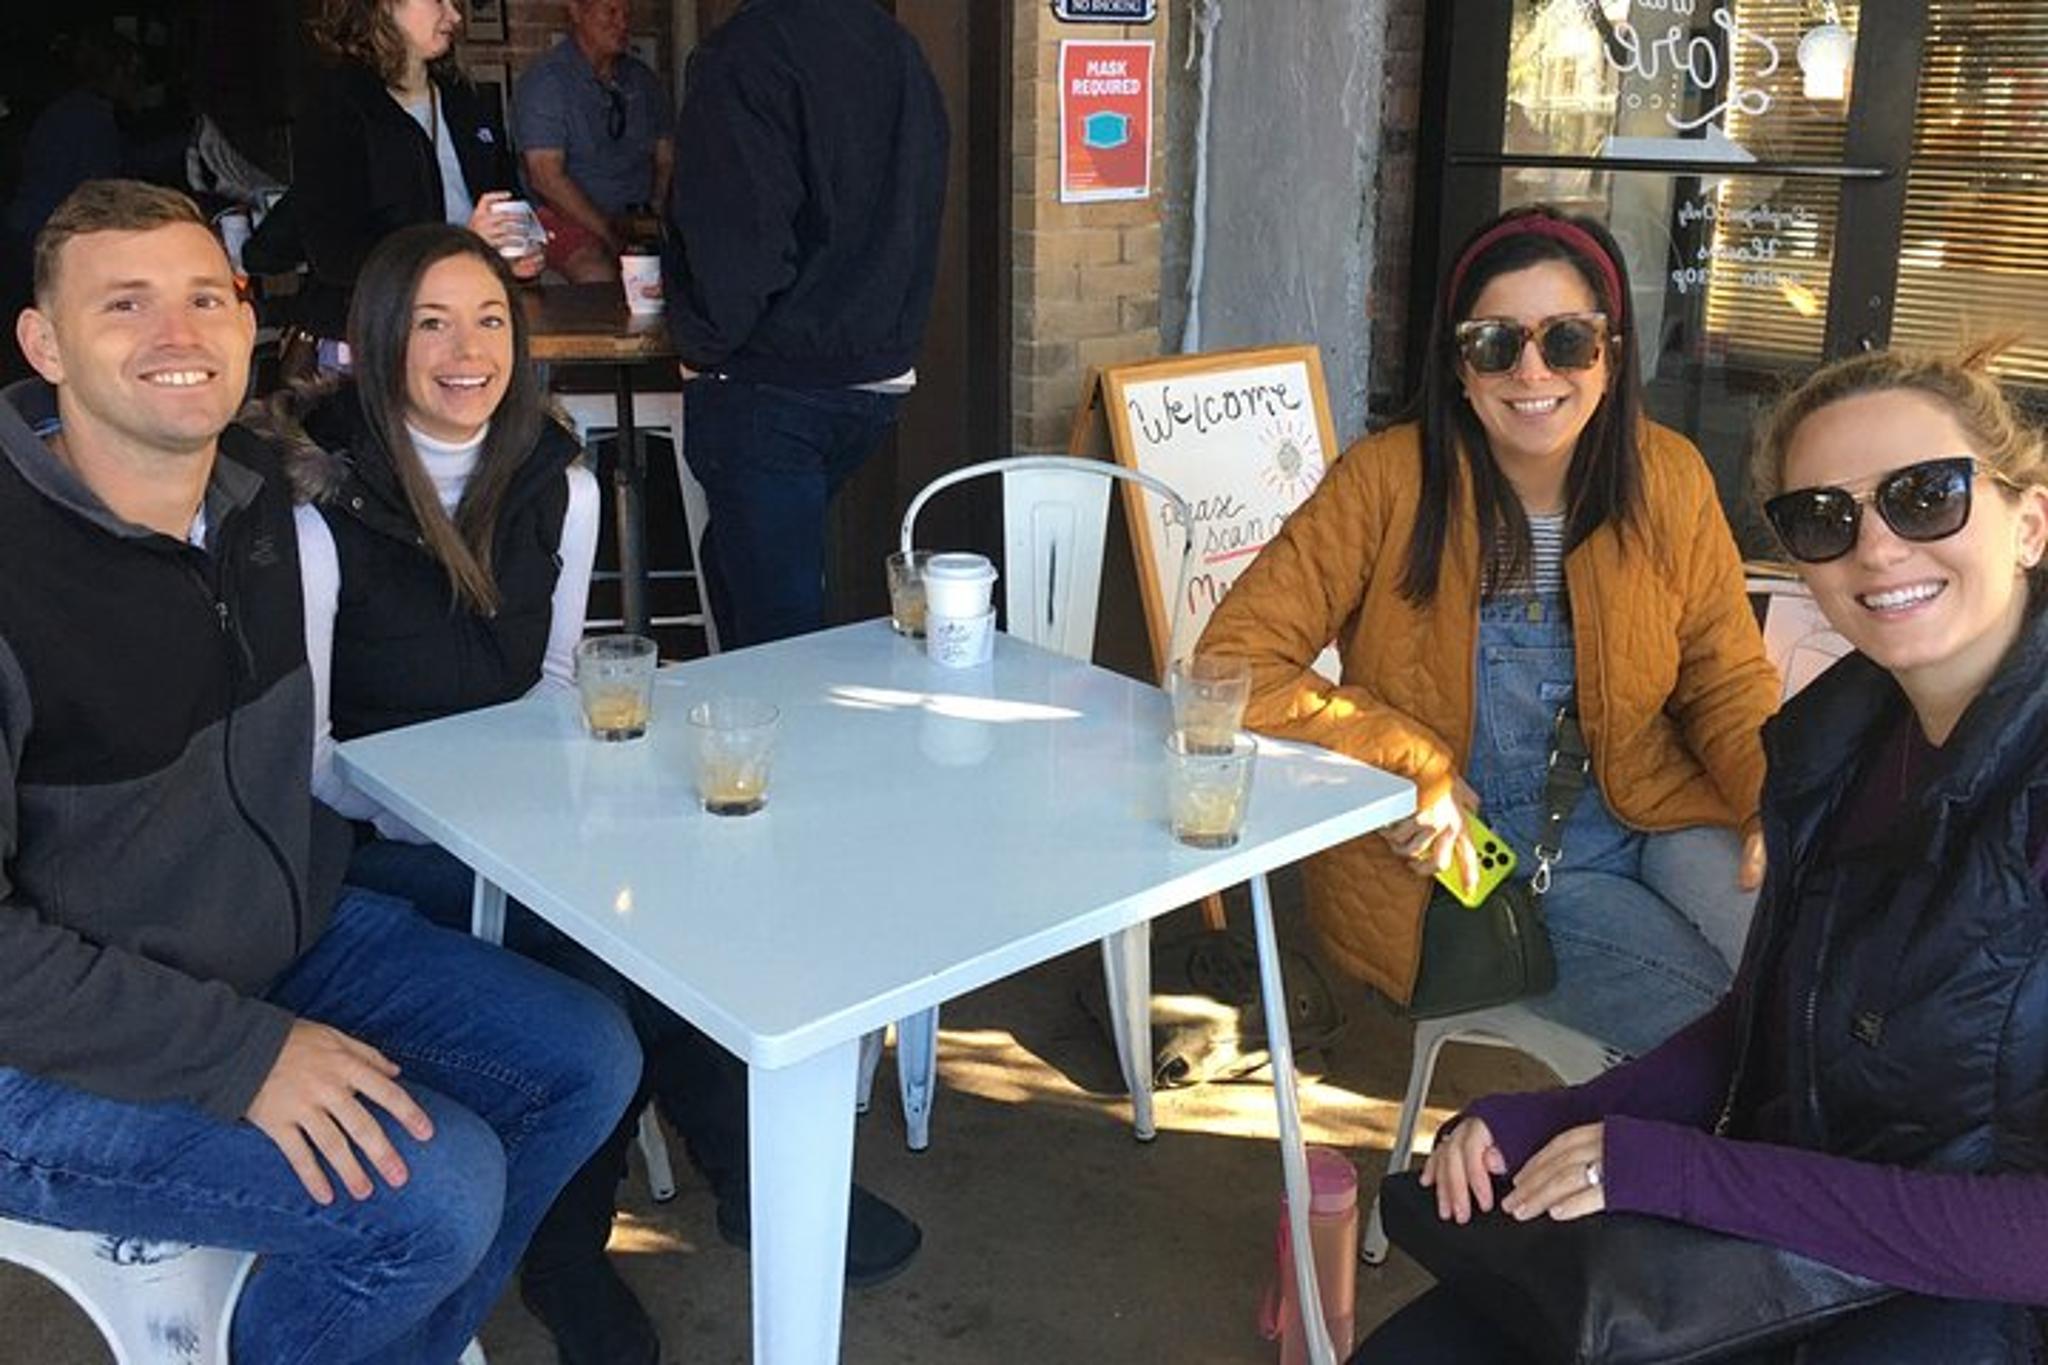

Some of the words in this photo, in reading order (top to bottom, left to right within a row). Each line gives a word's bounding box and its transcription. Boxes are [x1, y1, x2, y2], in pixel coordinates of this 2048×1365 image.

[1071, 0, 1090, 12] NO
[1086, 60, 1128, 78] MASK
[1072, 78, 1141, 98] REQUIRED
[1129, 383, 1301, 444] Welcome
